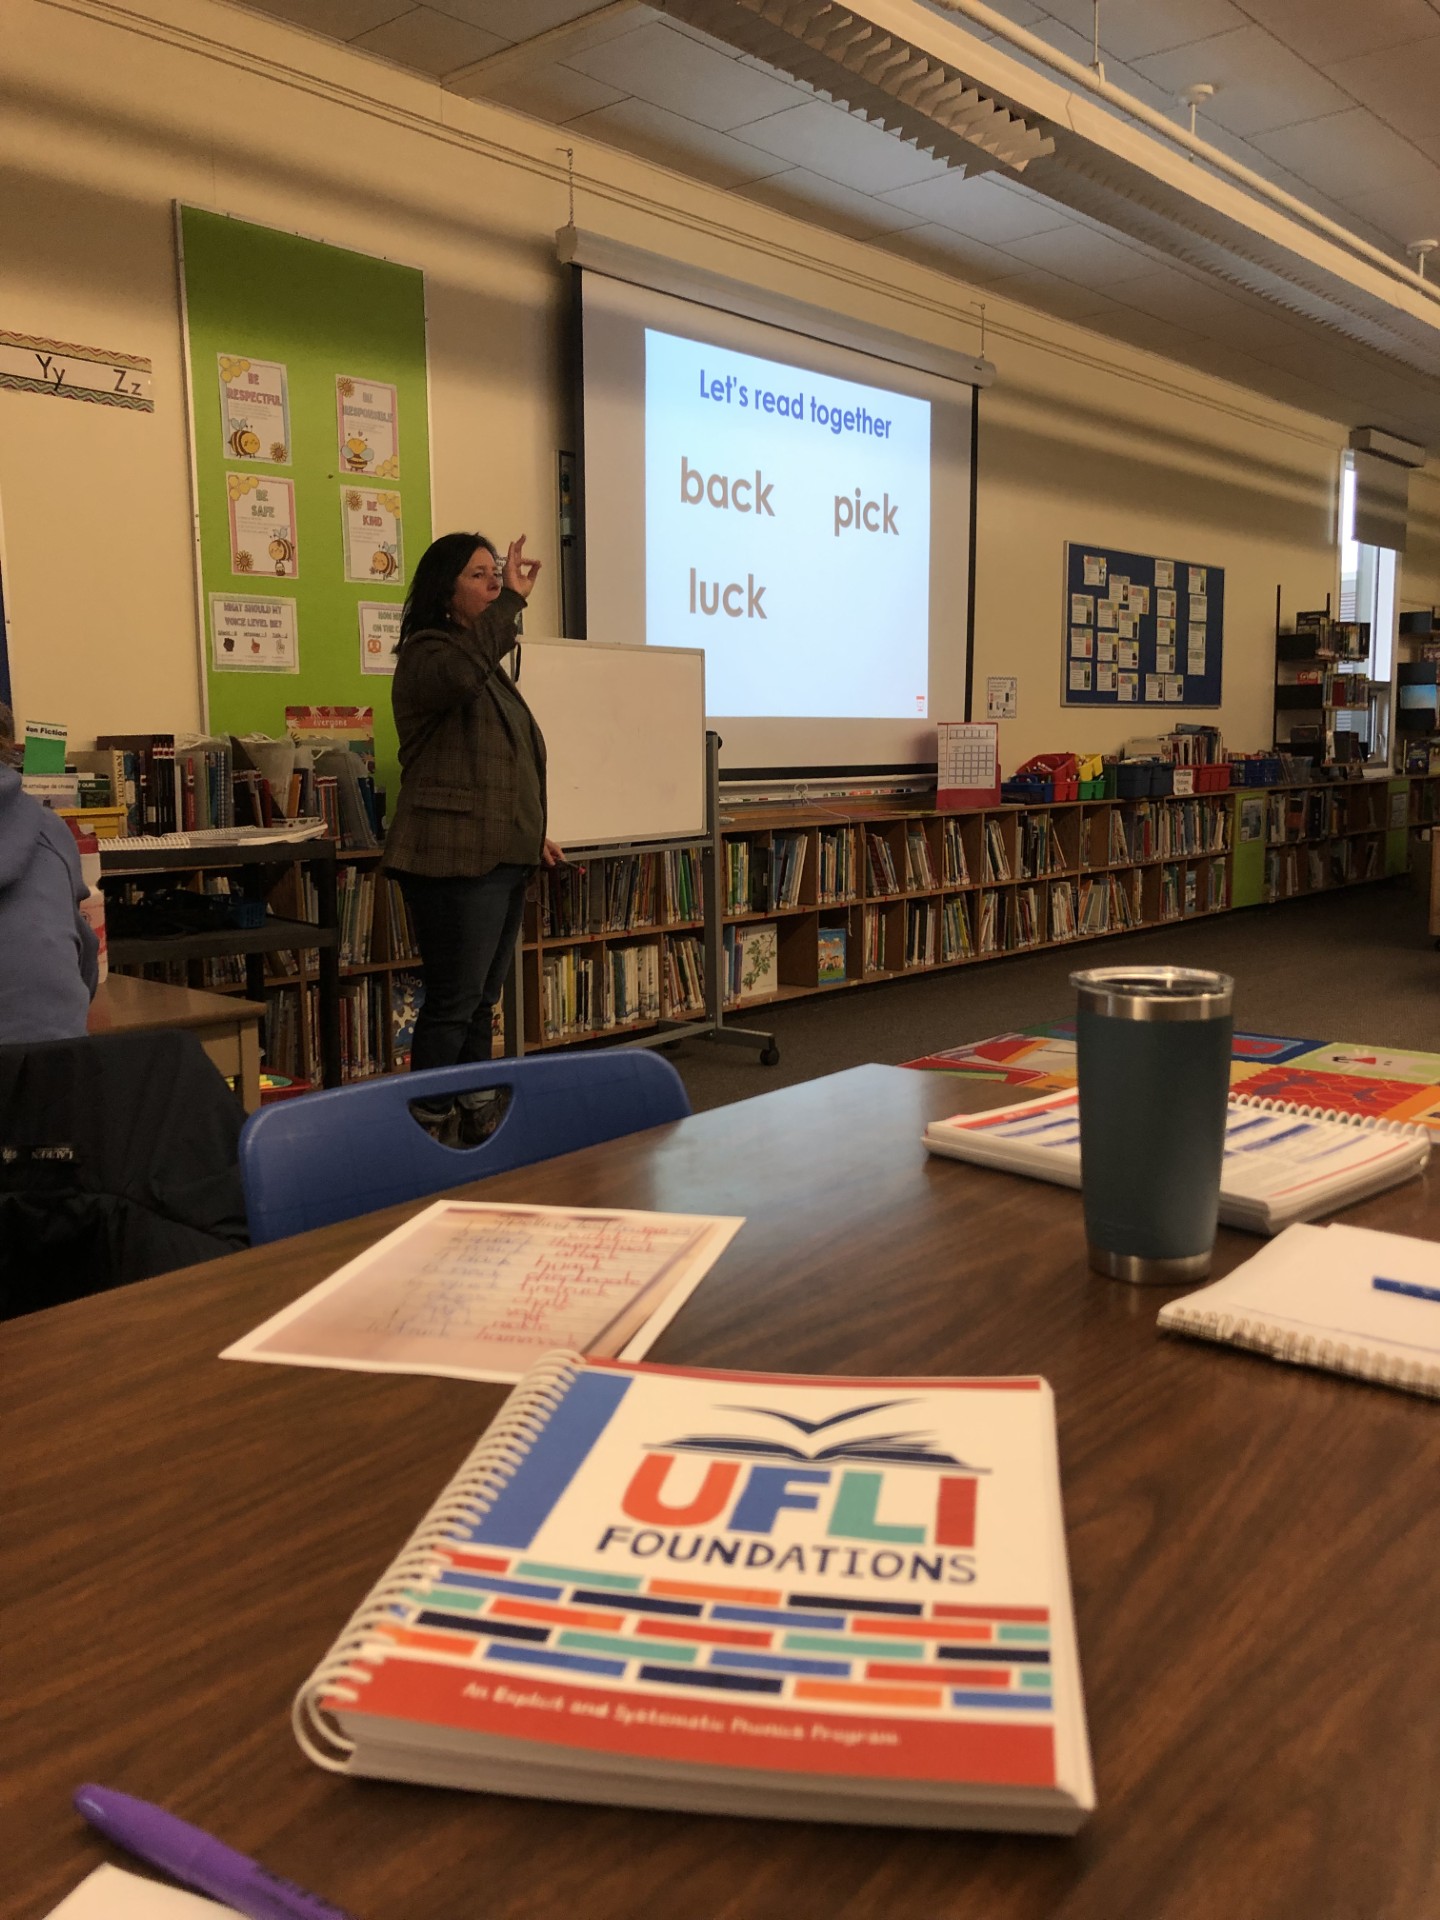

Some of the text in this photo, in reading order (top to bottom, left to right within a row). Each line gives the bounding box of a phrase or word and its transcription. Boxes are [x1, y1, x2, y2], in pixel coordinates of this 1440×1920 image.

[226, 387, 282, 406] RESPECTFUL
[700, 369, 891, 438] Let's read together
[251, 505, 275, 518] SAFE
[680, 456, 899, 537] back pick
[362, 515, 383, 527] KIND
[224, 602, 242, 612] WHAT
[244, 604, 271, 614] SHOULD
[689, 567, 767, 619] luck
[224, 617, 246, 626] VOICE
[247, 619, 268, 628] LEVEL
[40, 727, 68, 737] Fiction
[621, 1452, 979, 1548] UFLI
[596, 1526, 977, 1584] FOUNDATIONS
[463, 1682, 899, 1748] An Explicit and Systematic Phonics Program
